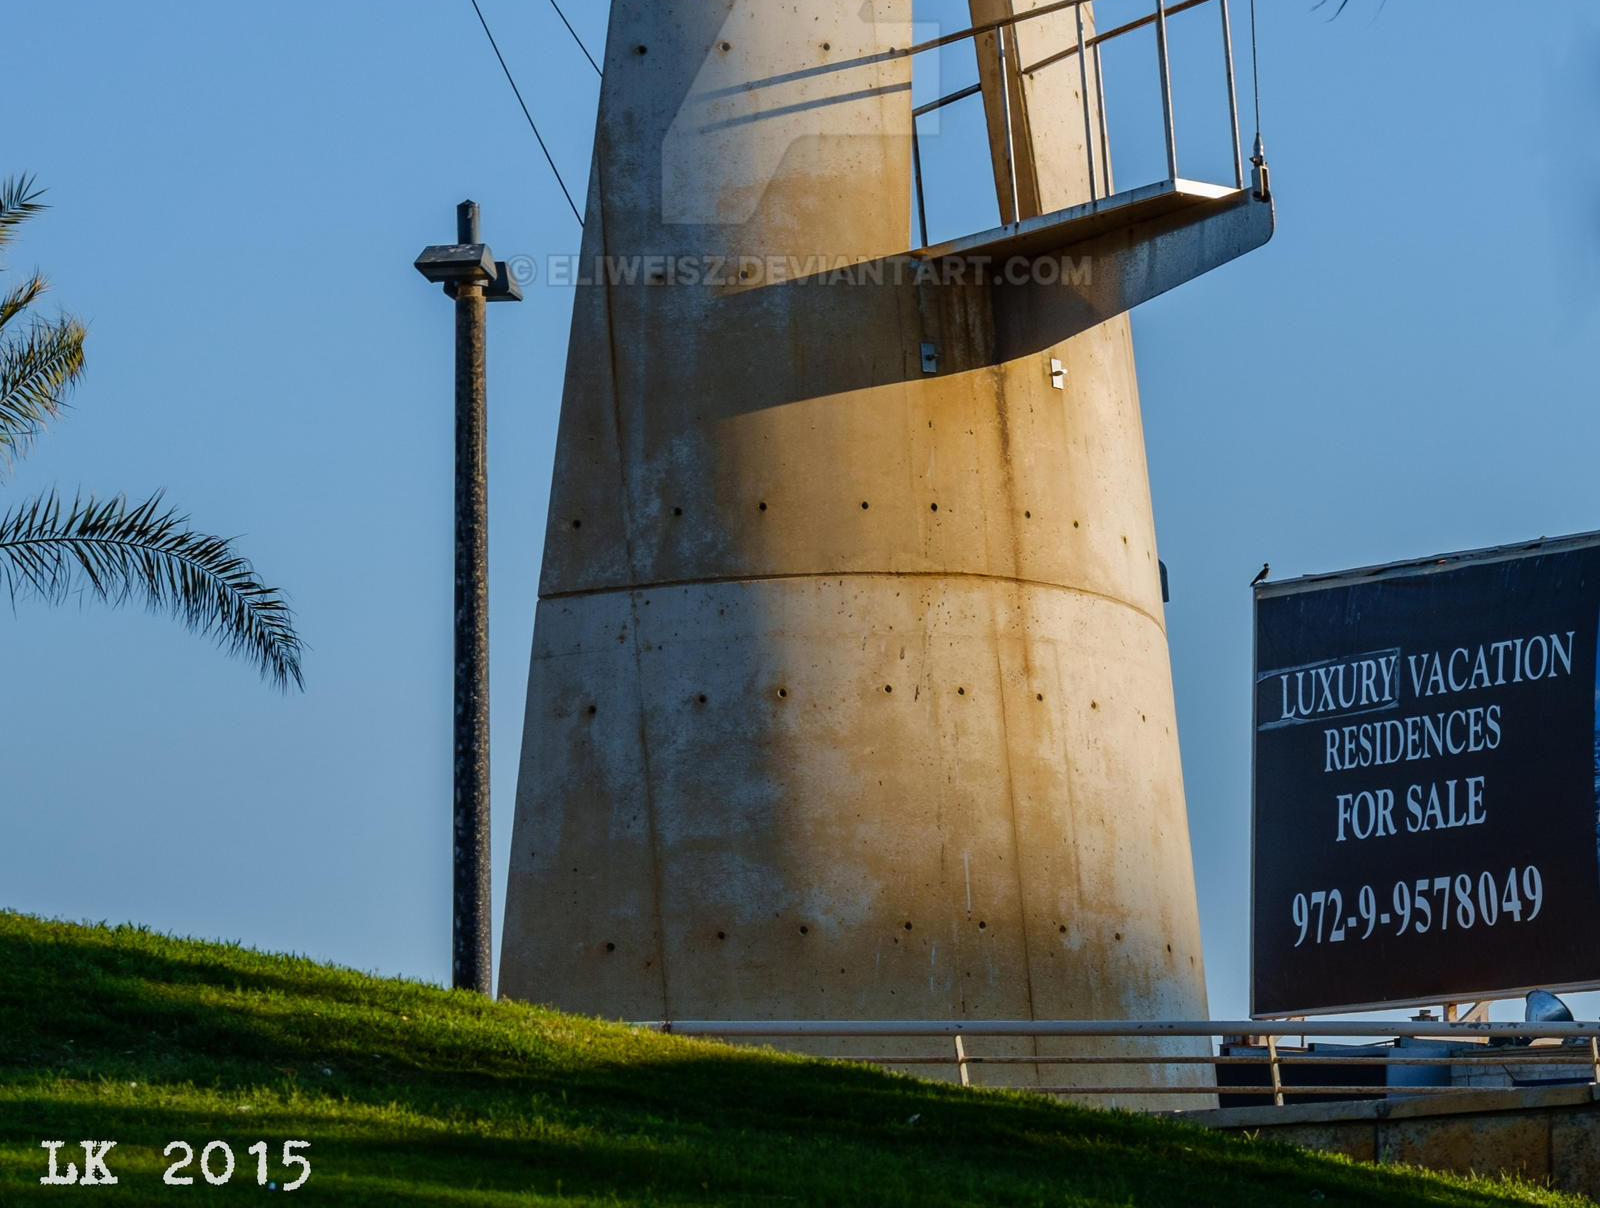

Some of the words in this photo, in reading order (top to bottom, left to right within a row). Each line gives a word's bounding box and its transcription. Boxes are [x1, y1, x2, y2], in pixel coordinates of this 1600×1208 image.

[1281, 655, 1397, 720] LUXURY
[1408, 630, 1576, 698] VACATION
[1324, 705, 1502, 773] RESIDENCES
[1336, 788, 1398, 843] FOR
[1406, 776, 1487, 834] SALE
[1292, 865, 1543, 948] 972-9-9578049
